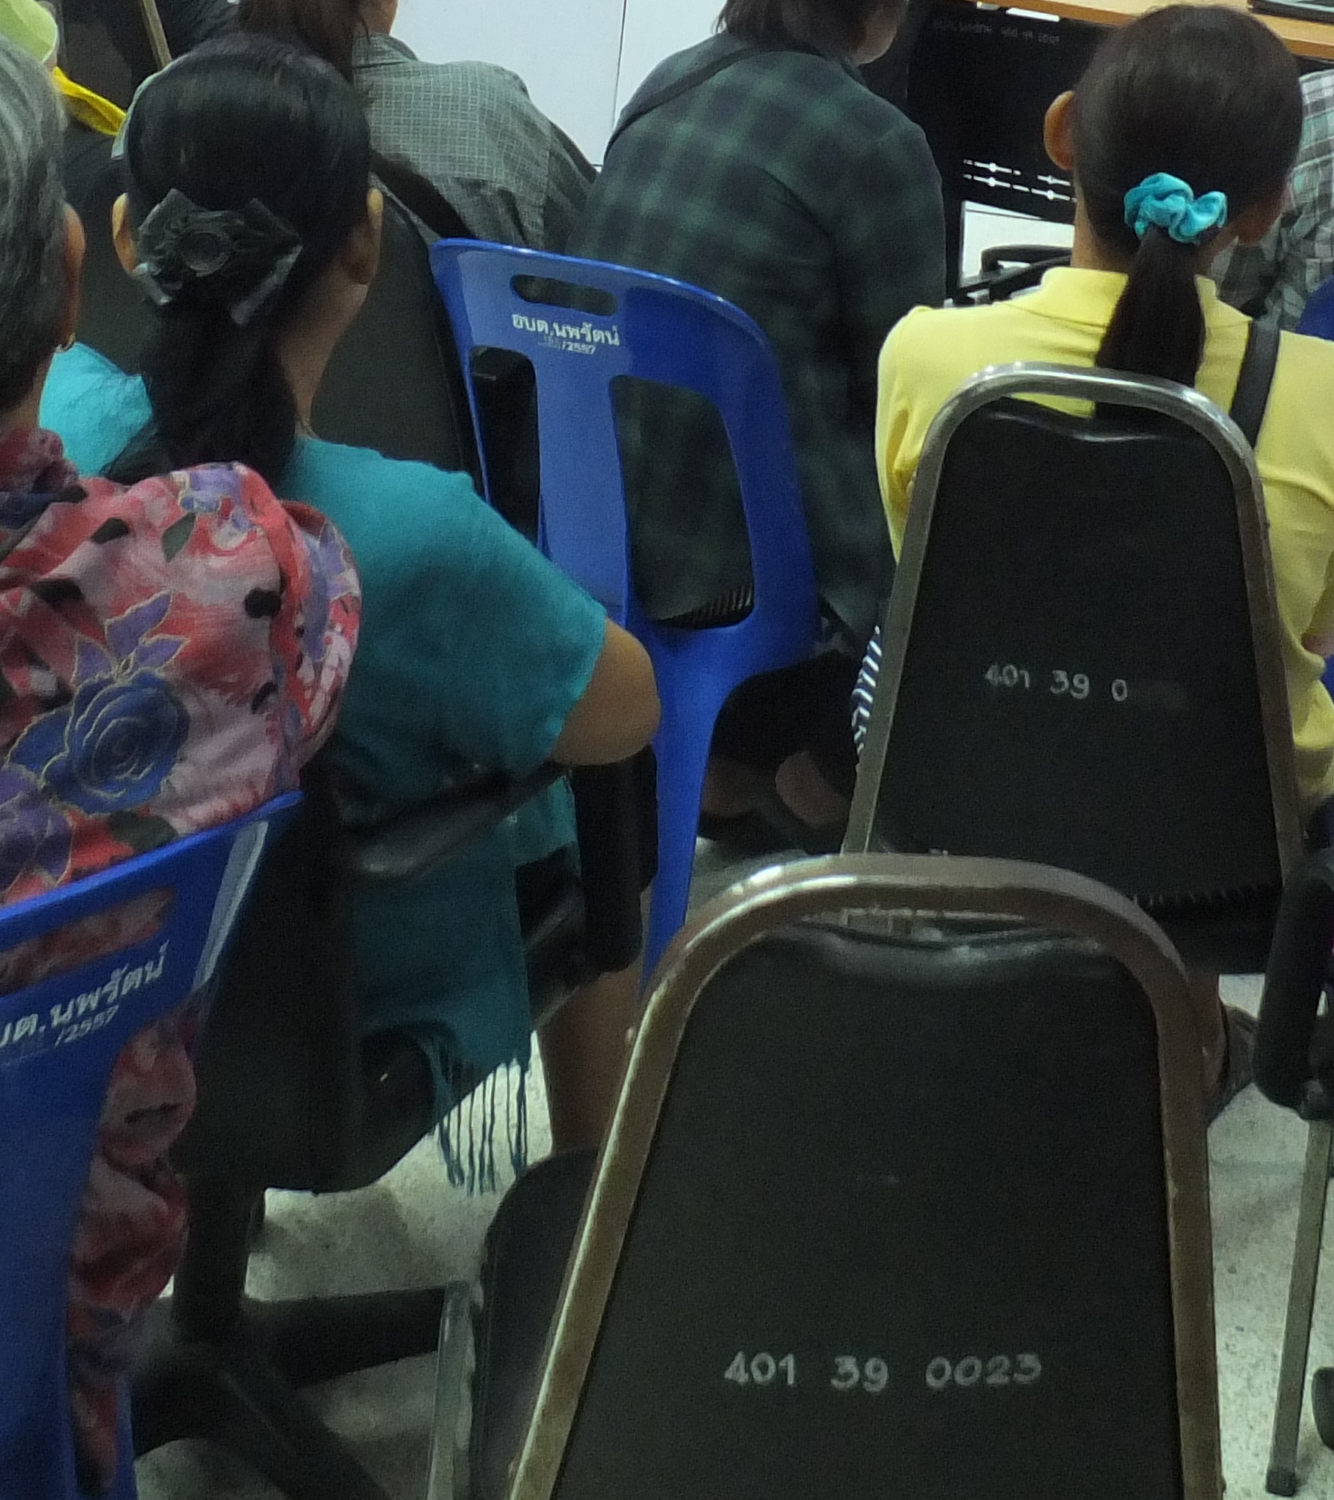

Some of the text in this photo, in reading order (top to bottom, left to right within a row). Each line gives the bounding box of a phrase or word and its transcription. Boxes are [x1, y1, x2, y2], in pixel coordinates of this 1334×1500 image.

[1050, 669, 1090, 699] 39
[723, 1350, 797, 1387] 401
[830, 1354, 889, 1393] 39
